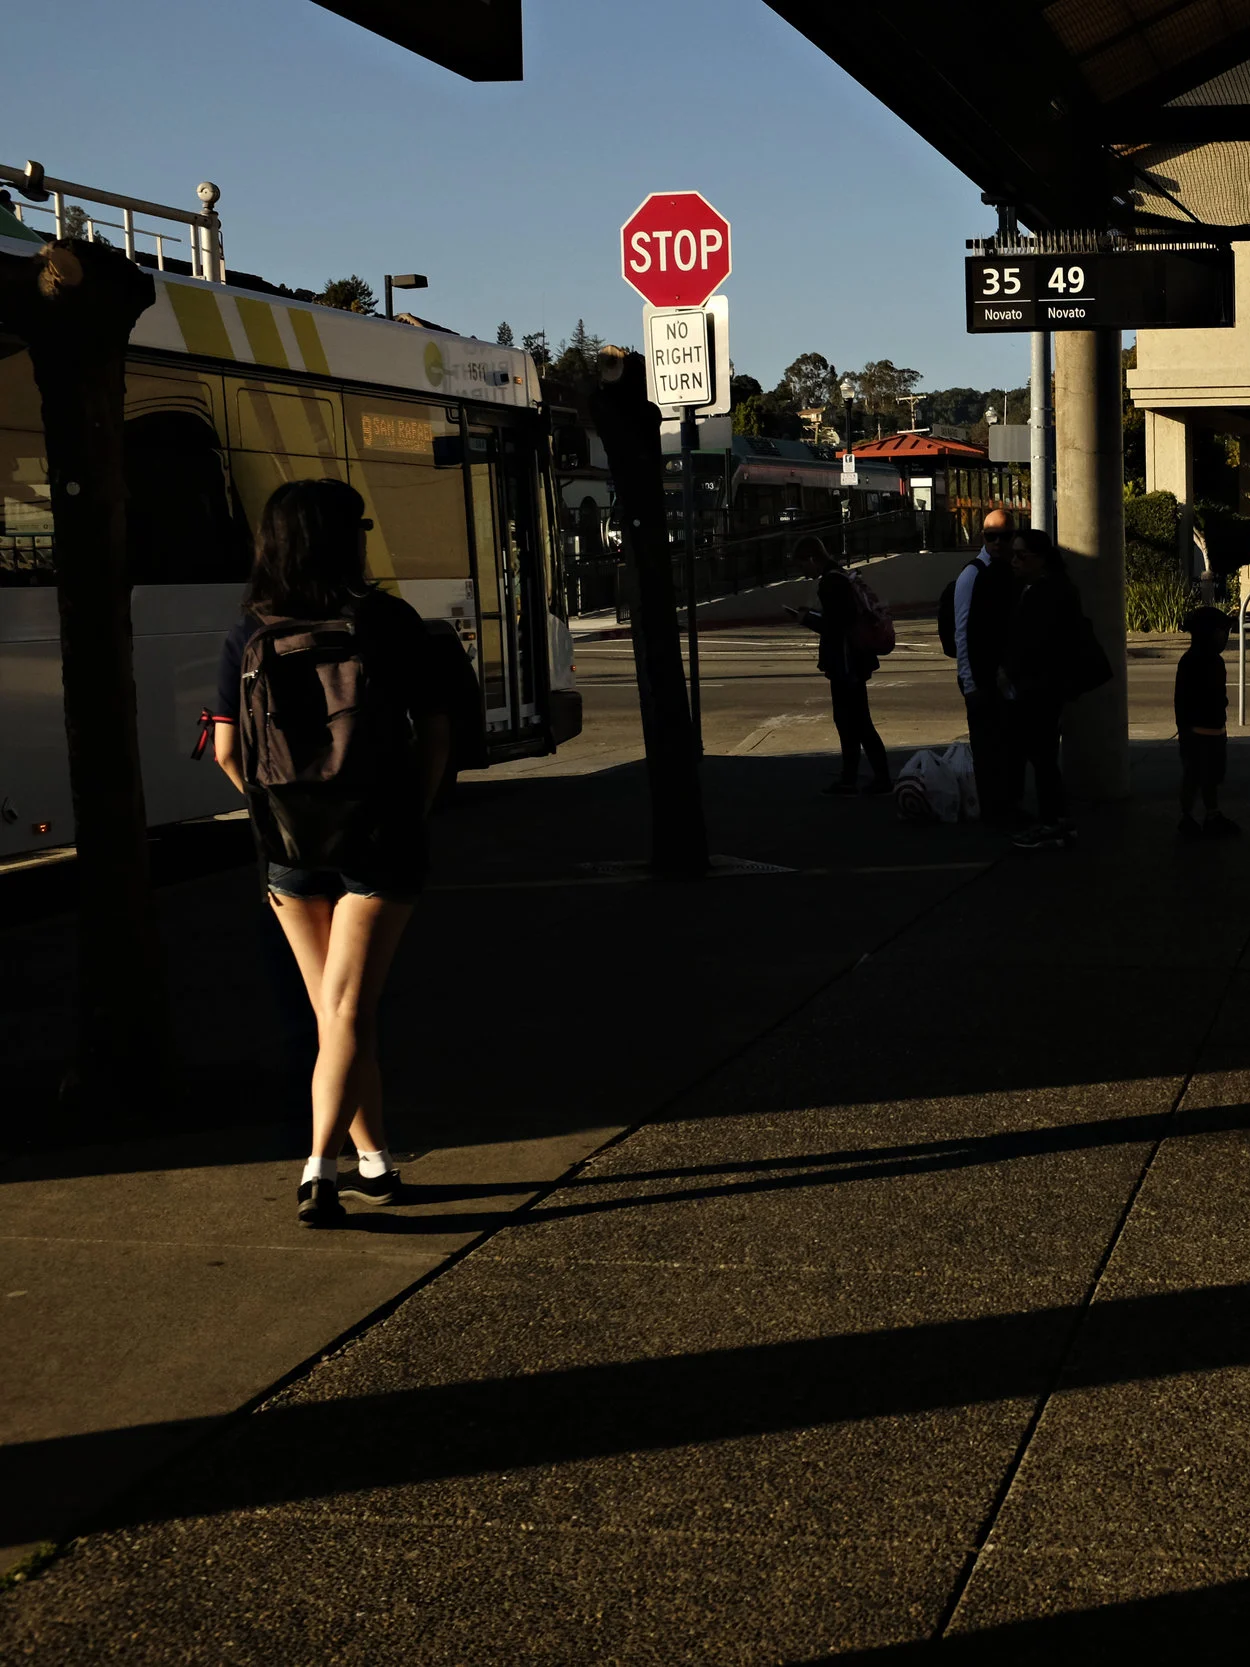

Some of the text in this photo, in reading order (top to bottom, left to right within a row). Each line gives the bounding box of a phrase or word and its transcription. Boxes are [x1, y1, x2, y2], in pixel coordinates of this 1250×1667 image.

[630, 228, 723, 273] STOP
[982, 266, 1085, 295] 35 49
[984, 306, 1086, 321] Novato Novato
[666, 321, 688, 340] NO
[656, 345, 703, 367] RIGHT
[659, 371, 703, 392] TURN
